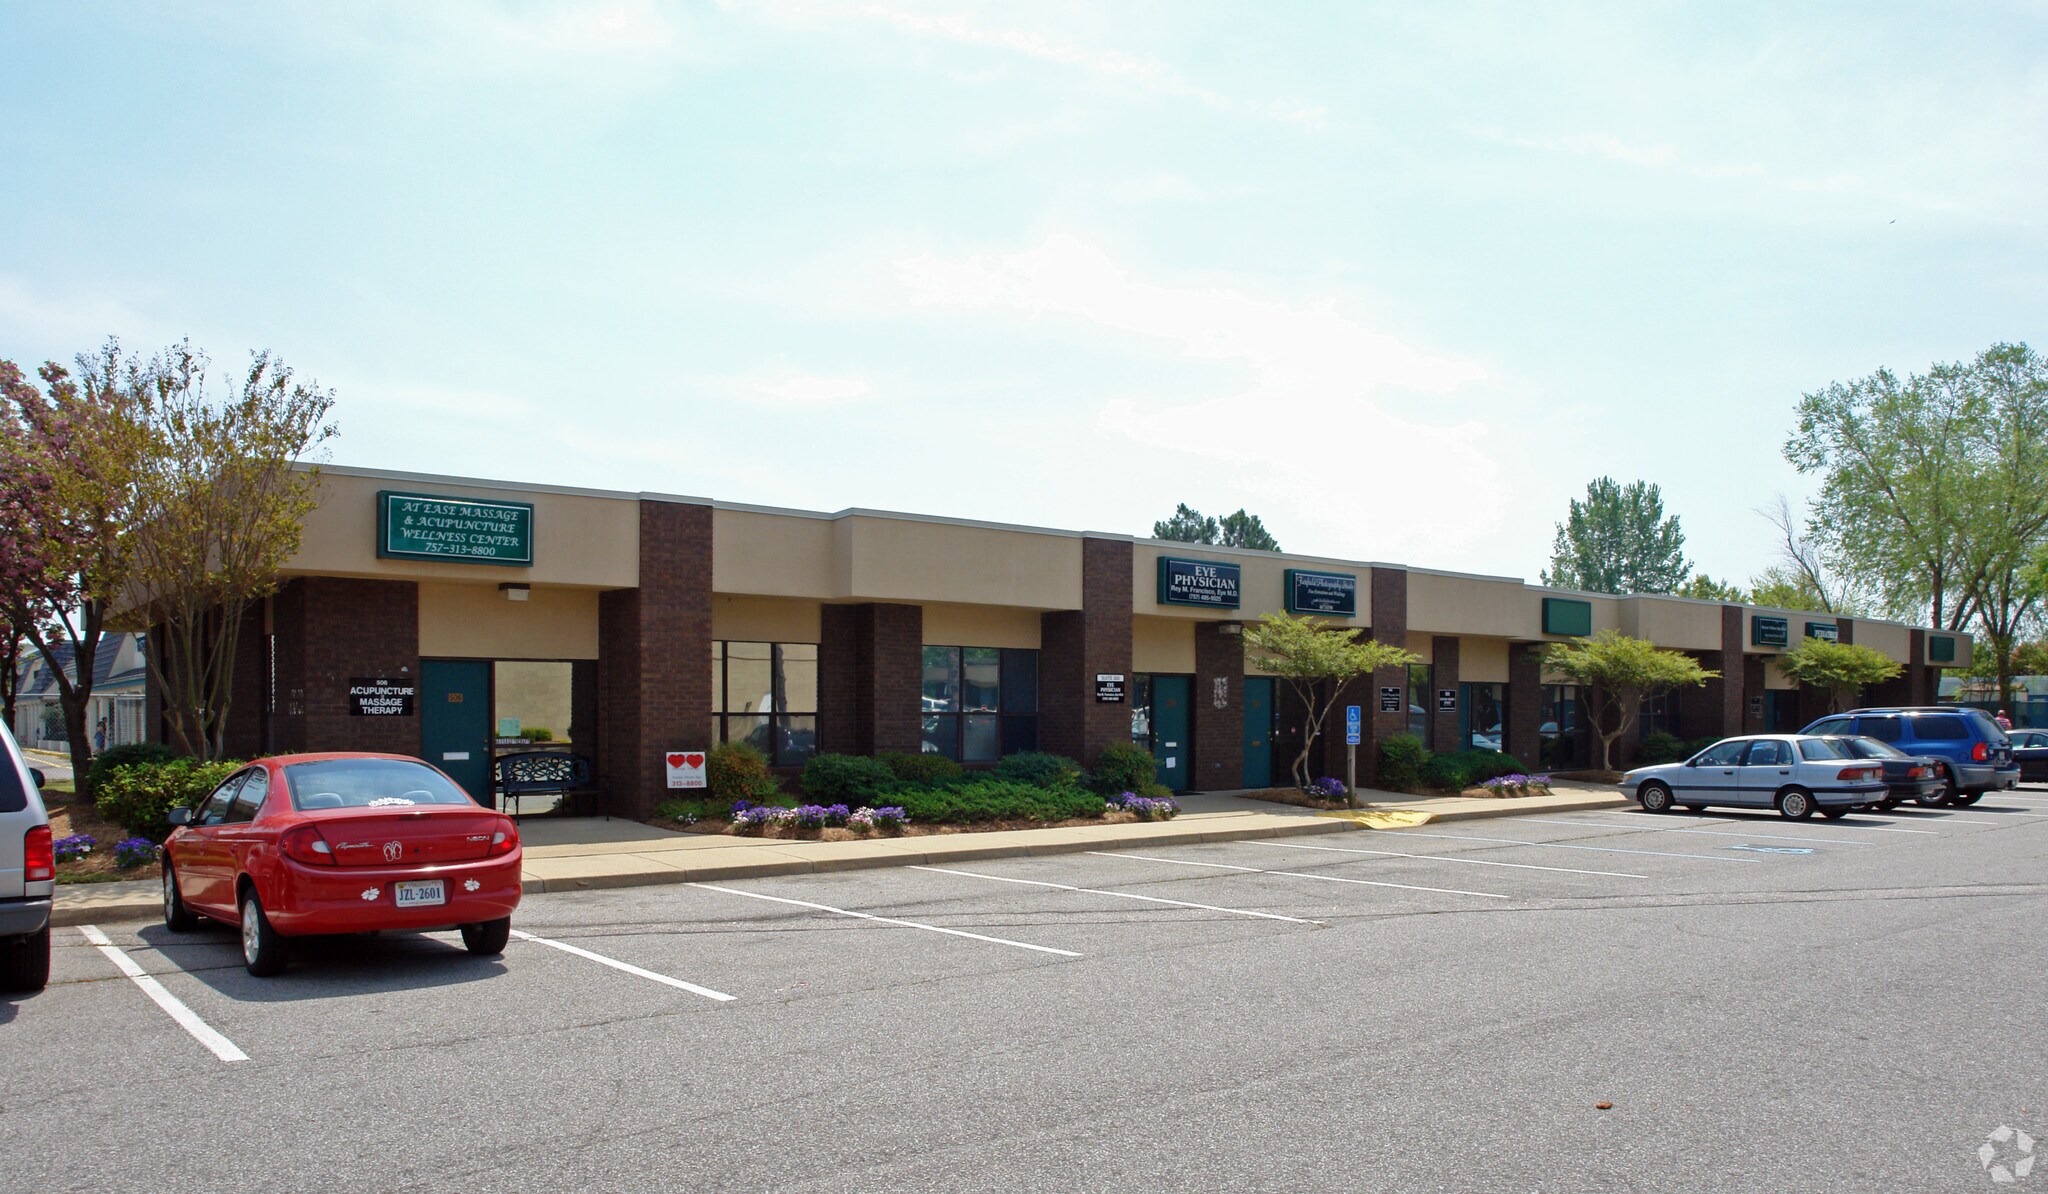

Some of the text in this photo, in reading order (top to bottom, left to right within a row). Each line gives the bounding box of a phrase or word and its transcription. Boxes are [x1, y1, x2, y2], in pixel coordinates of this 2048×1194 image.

[401, 501, 519, 521] AT EASE MASSAGE
[404, 515, 516, 533] & ACUPUNCTURE
[400, 527, 519, 547] WELLNESS CENTER
[425, 542, 496, 556] 757-313-8800
[1195, 566, 1217, 578] EYE
[1174, 574, 1235, 590] PHYSICIAN
[1190, 587, 1216, 596] Francisco,
[1217, 588, 1226, 597] Eye
[350, 686, 414, 695] ACUPUNCTURE
[359, 697, 403, 706] MASSAGE
[362, 706, 403, 715] THERAPY
[335, 840, 374, 850] Plymouth
[399, 887, 441, 901] JZL-2601
